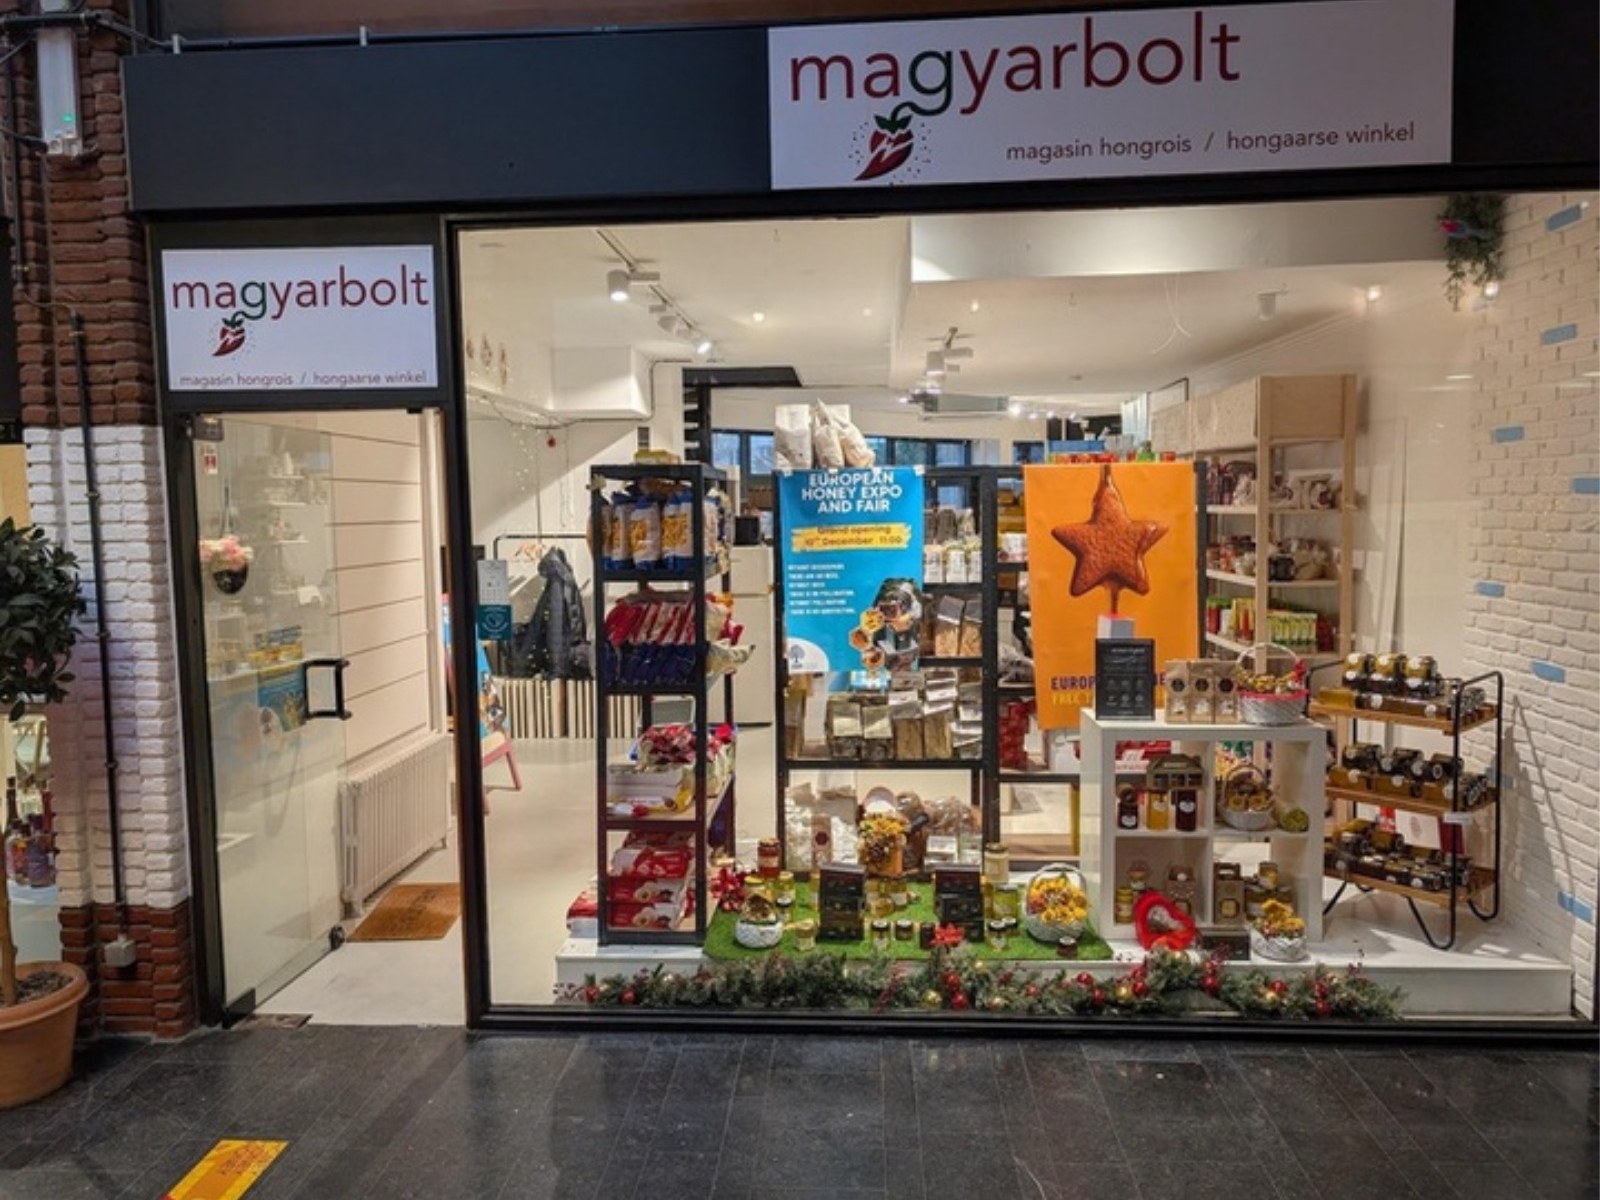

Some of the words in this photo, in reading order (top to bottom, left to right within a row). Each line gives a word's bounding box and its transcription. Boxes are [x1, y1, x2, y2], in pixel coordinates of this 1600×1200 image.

[789, 11, 1241, 115] magyarbolt
[1006, 139, 1093, 165] magasin
[1099, 133, 1193, 161] hongrois
[1226, 131, 1339, 154] hongaarse
[1345, 120, 1415, 144] winkel
[172, 264, 430, 321] magyarbolt
[179, 373, 234, 389] magasin
[237, 373, 293, 388] hongrois
[313, 371, 380, 387] hongaarse
[384, 369, 426, 384] winkel
[809, 472, 894, 487] EUROPEAN
[801, 487, 857, 501] HONEY
[861, 484, 903, 499] EXPO
[817, 501, 852, 514] AND
[856, 499, 891, 512] FAIR
